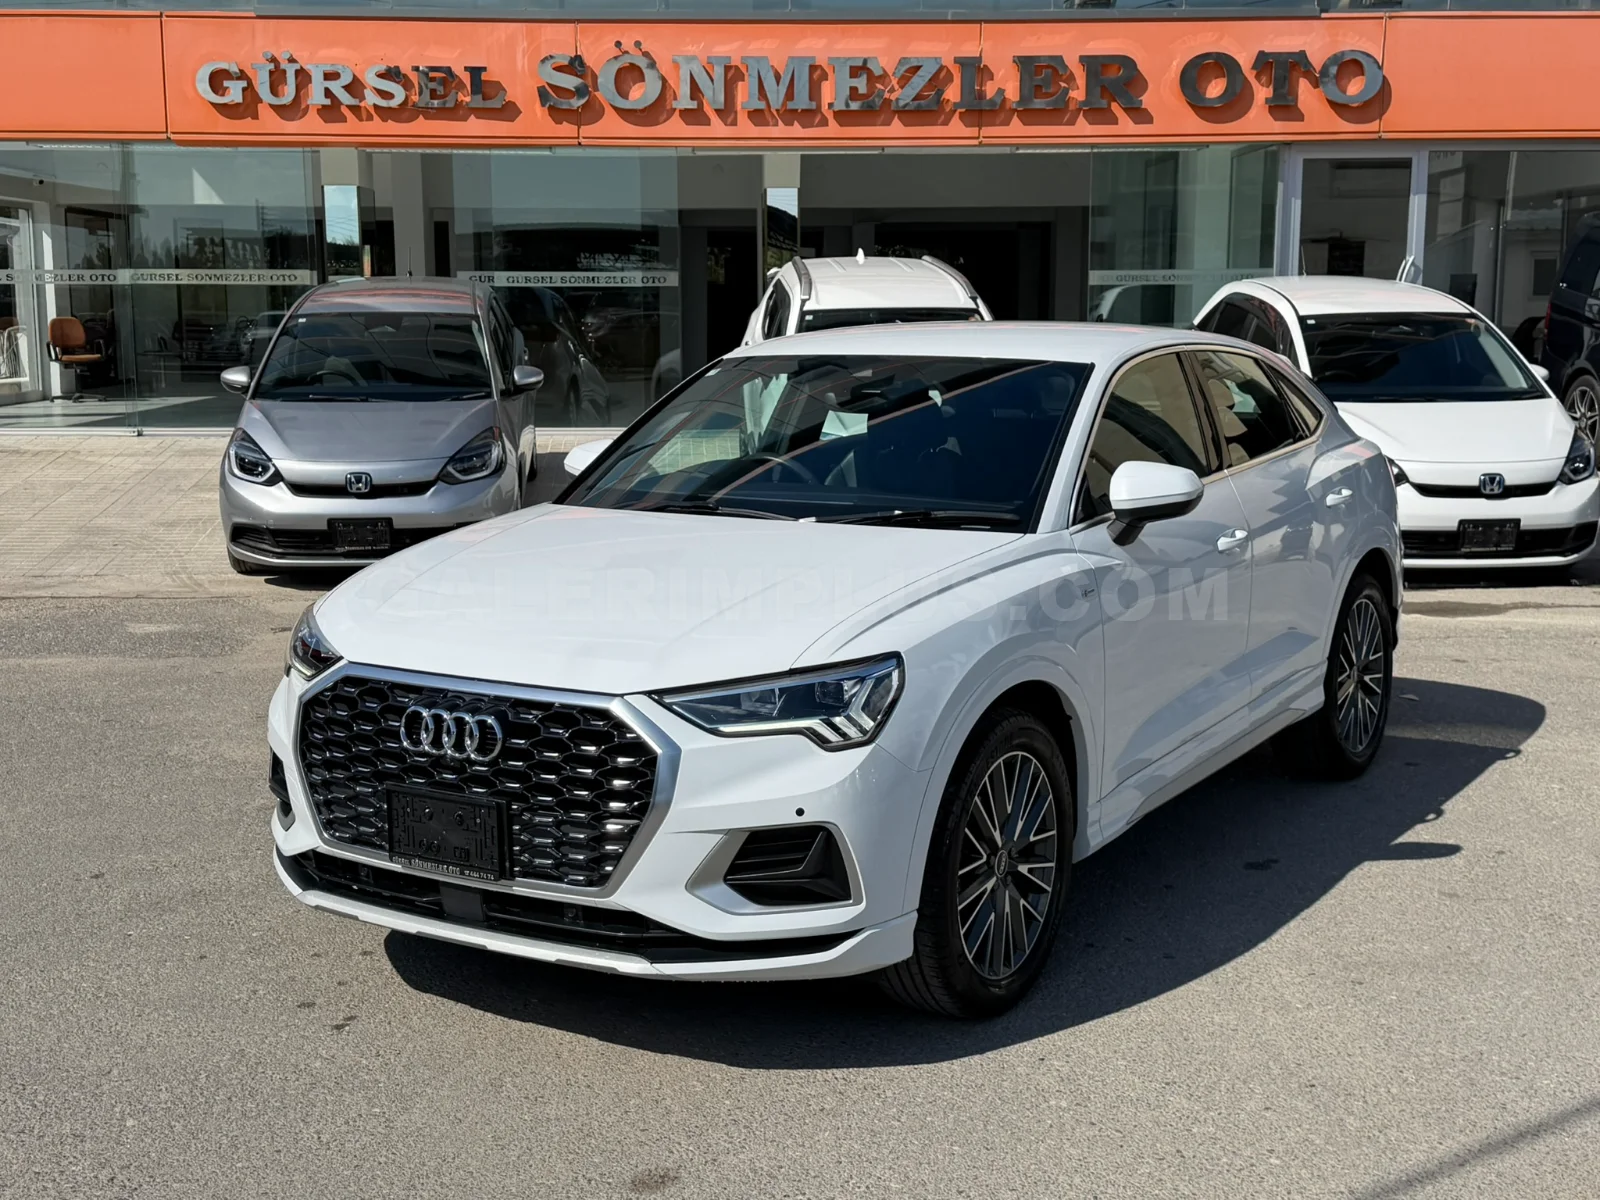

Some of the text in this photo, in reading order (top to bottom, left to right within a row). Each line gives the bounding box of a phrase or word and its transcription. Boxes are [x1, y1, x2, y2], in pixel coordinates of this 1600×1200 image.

[195, 40, 1384, 111] GÜRSEL SÖNMEZLER OTO
[89, 273, 118, 283] OTO
[269, 273, 299, 283] OTO
[641, 274, 668, 285] OTO
